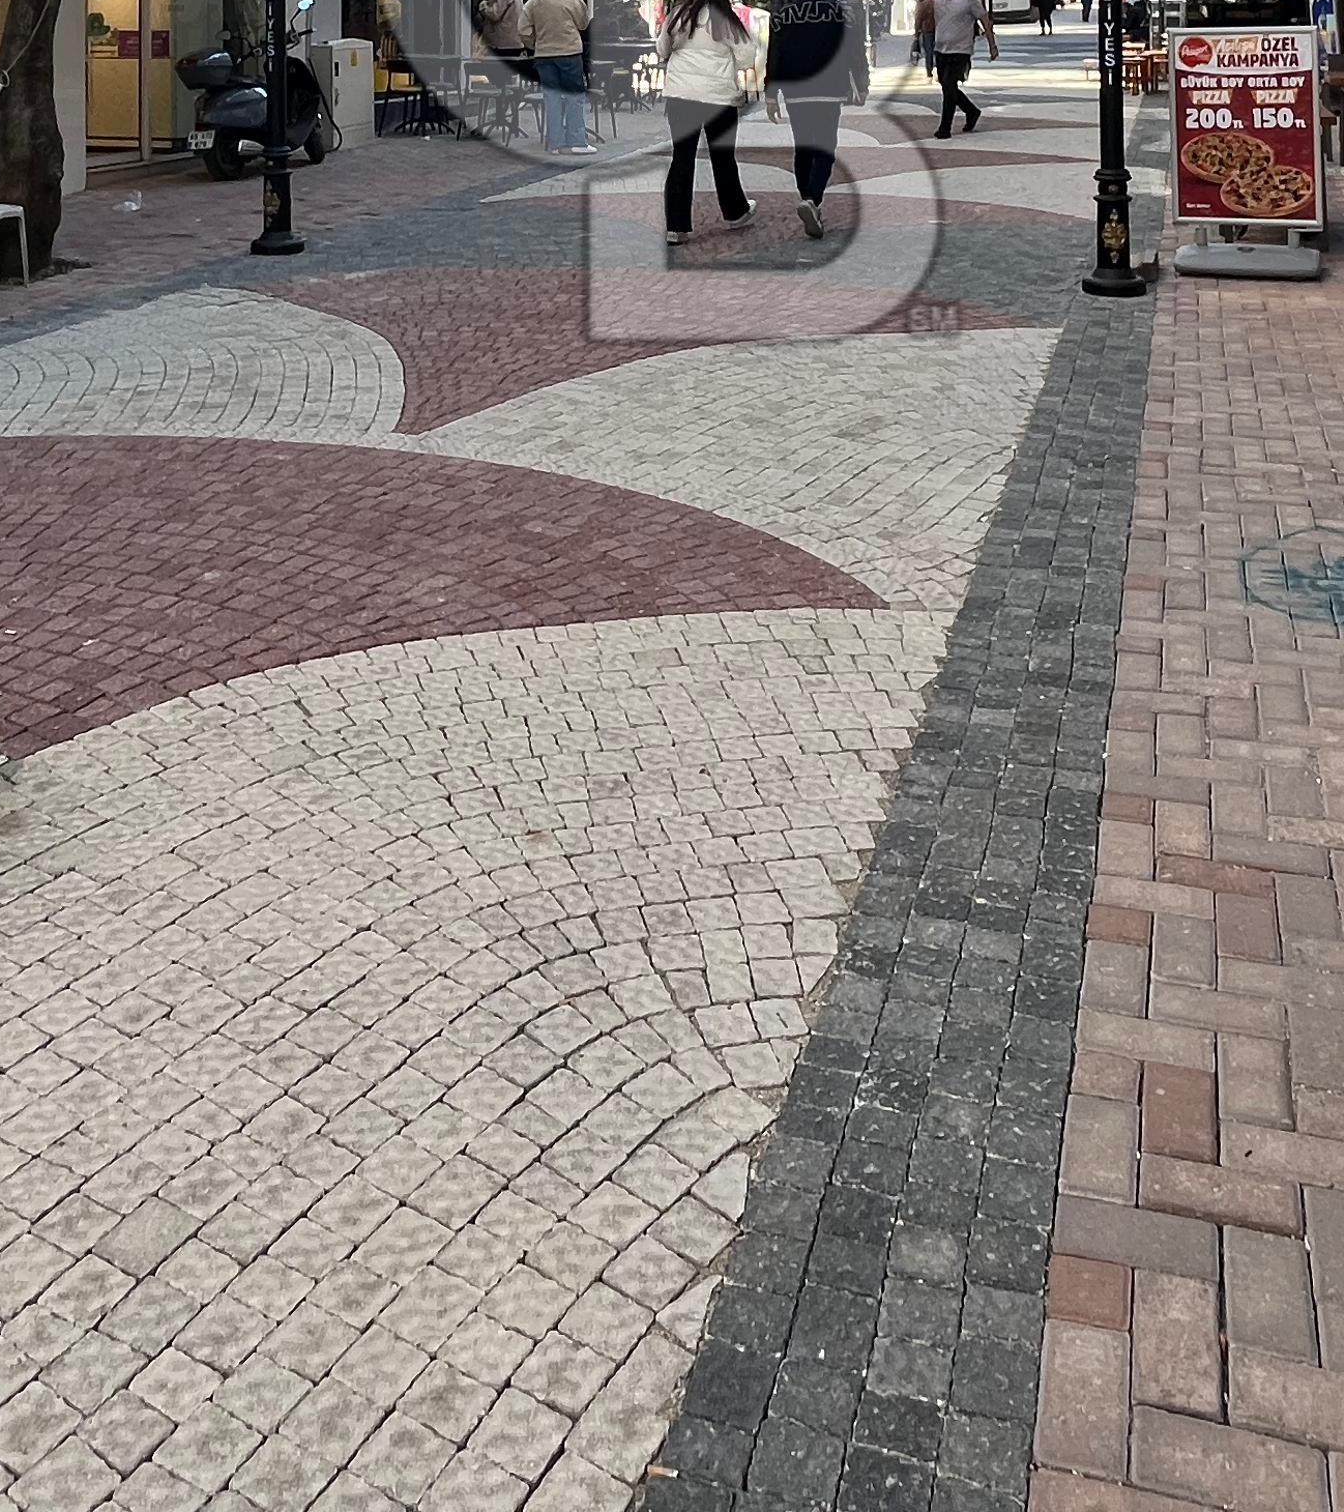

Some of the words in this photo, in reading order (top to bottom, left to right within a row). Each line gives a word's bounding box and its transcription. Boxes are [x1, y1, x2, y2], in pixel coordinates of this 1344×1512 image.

[1261, 34, 1299, 52] ÖZEL
[1217, 53, 1299, 67] KAMPANYA
[1181, 75, 1218, 88] BÜYÜK
[1221, 77, 1244, 88] BOY
[1248, 77, 1278, 88] ORTA
[1281, 76, 1305, 88] BOY
